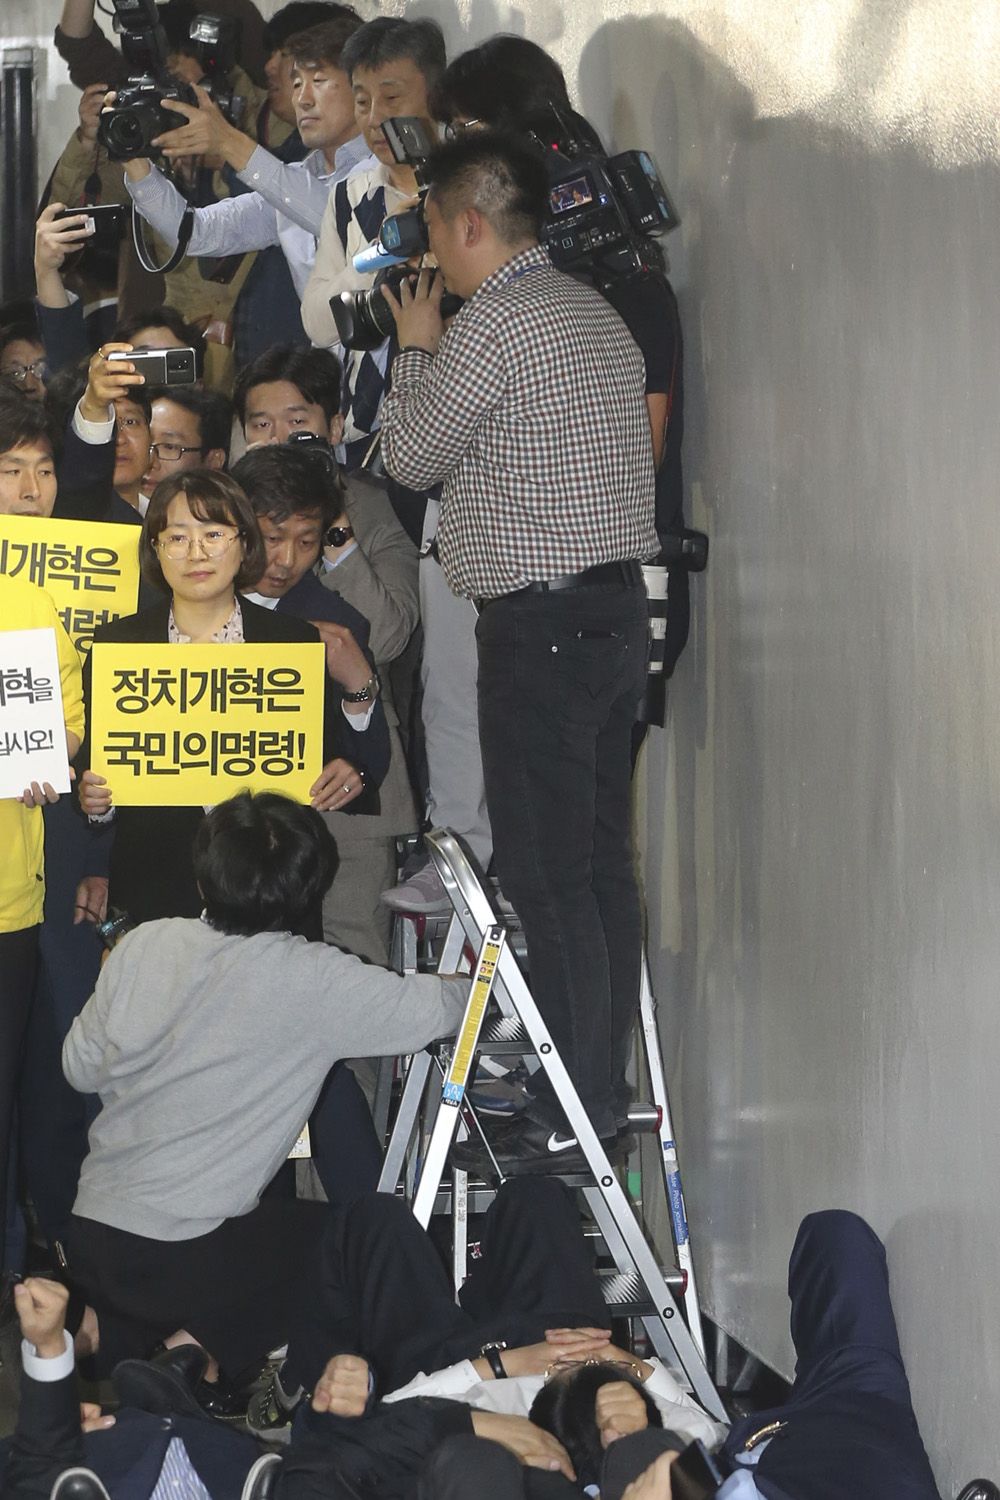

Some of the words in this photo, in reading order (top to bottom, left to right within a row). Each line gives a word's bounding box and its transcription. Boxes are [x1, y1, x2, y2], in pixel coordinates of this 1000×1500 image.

[112, 668, 305, 714] 정치개혁은
[103, 730, 306, 776] 국민의명령!
[674, 1210, 685, 1243] journalists
